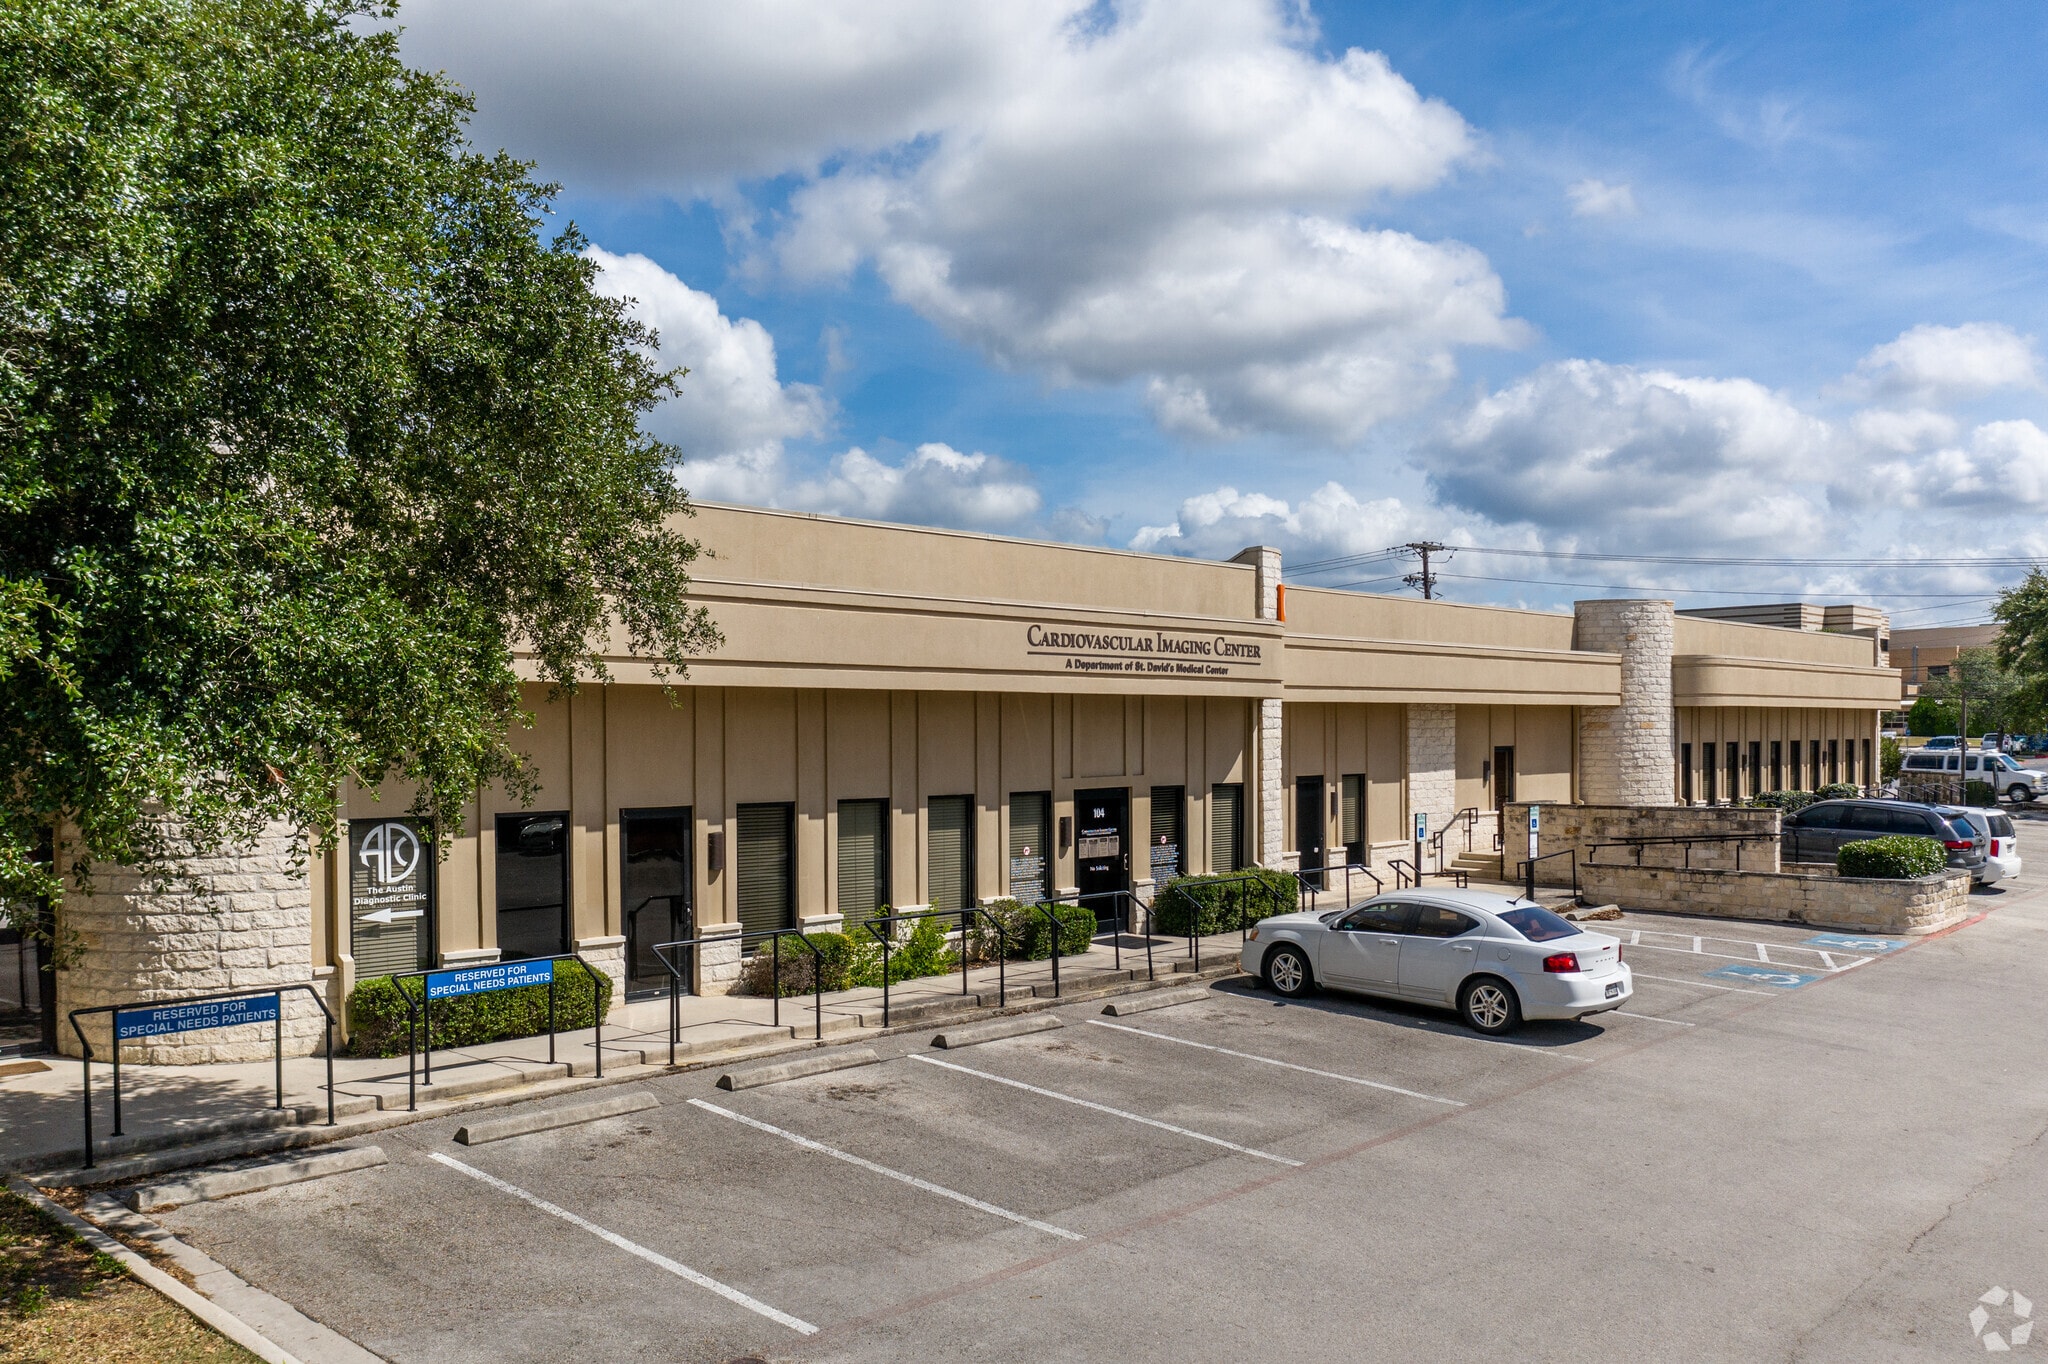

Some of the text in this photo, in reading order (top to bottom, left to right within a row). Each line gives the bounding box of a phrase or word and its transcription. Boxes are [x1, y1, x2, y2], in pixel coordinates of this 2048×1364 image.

[1065, 658, 1229, 675] A Department of St. David's Medical Center
[1093, 808, 1105, 818] 104
[366, 884, 414, 895] The Austin
[353, 892, 427, 906] Diagnostic Clinic
[454, 965, 527, 983] RESERVED FOR
[430, 972, 551, 997] SPECIAL NEEDS PATIENTS
[152, 1001, 247, 1021] RESERVED FOR
[120, 1008, 277, 1038] SPECIAL NEEDS PATIENTS
